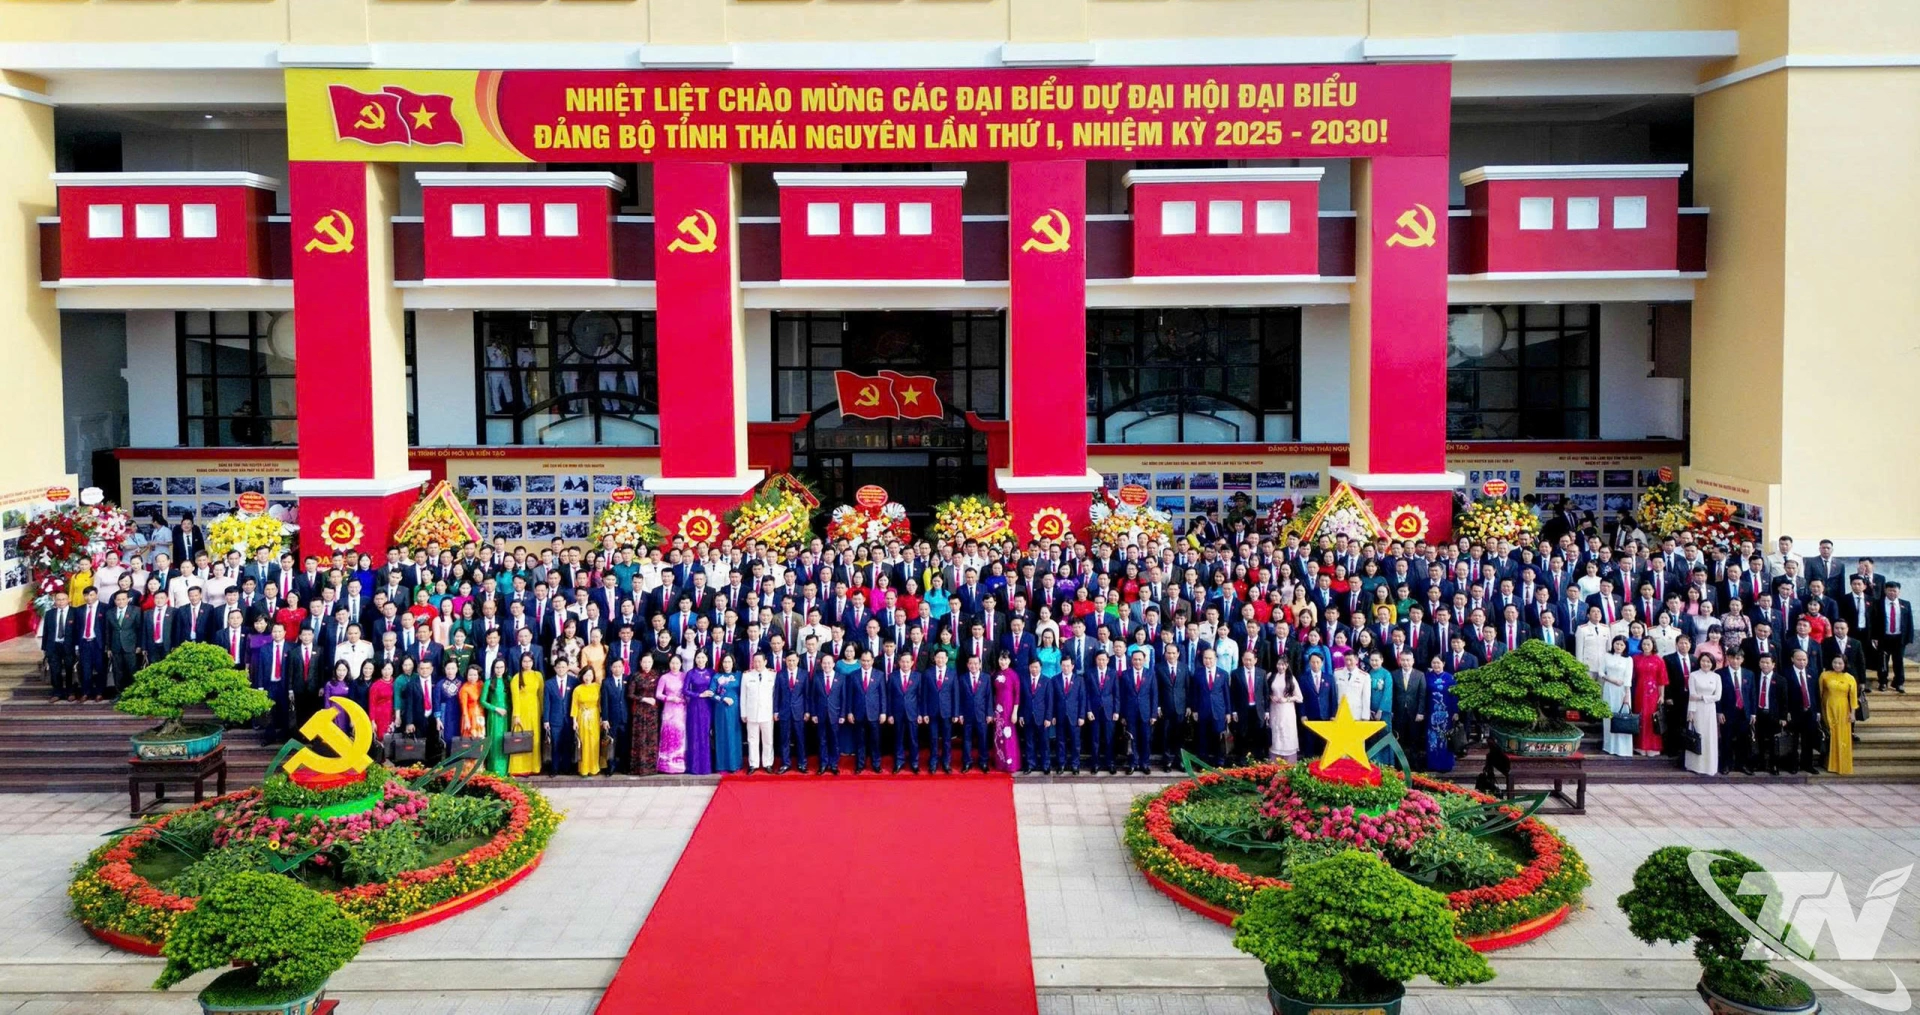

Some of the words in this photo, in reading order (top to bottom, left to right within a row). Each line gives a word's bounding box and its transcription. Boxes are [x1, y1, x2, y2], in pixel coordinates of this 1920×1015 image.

[565, 82, 646, 117] NHIỆT
[654, 82, 710, 117] LIỆT
[718, 82, 792, 113] CHÀO
[801, 82, 884, 113] MỪNG
[892, 81, 948, 112] CÁC
[955, 86, 1002, 117] ĐẠI
[1011, 74, 1074, 111] BIỂU
[1082, 81, 1123, 115] DỰ
[1127, 83, 1174, 115] ĐẠI
[1183, 78, 1230, 114] HỘI
[1237, 83, 1285, 114] ĐẠI
[1293, 73, 1357, 108] BIỂU
[533, 116, 610, 149] ĐẢNG
[618, 119, 656, 154] BỘ
[663, 116, 727, 149] TỈNH
[735, 119, 797, 149] THÁI
[805, 119, 916, 150] NGUYÊN
[924, 115, 978, 149] LẦN
[985, 117, 1042, 148] THỨ
[1046, 122, 1064, 150] I,
[1072, 116, 1163, 152] NHIỆM
[1171, 115, 1207, 146] KỲ
[1215, 120, 1283, 146] 2025
[1310, 118, 1388, 145] 2030!
[466, 449, 475, 457] VÀ
[1289, 445, 1299, 453] BỘ
